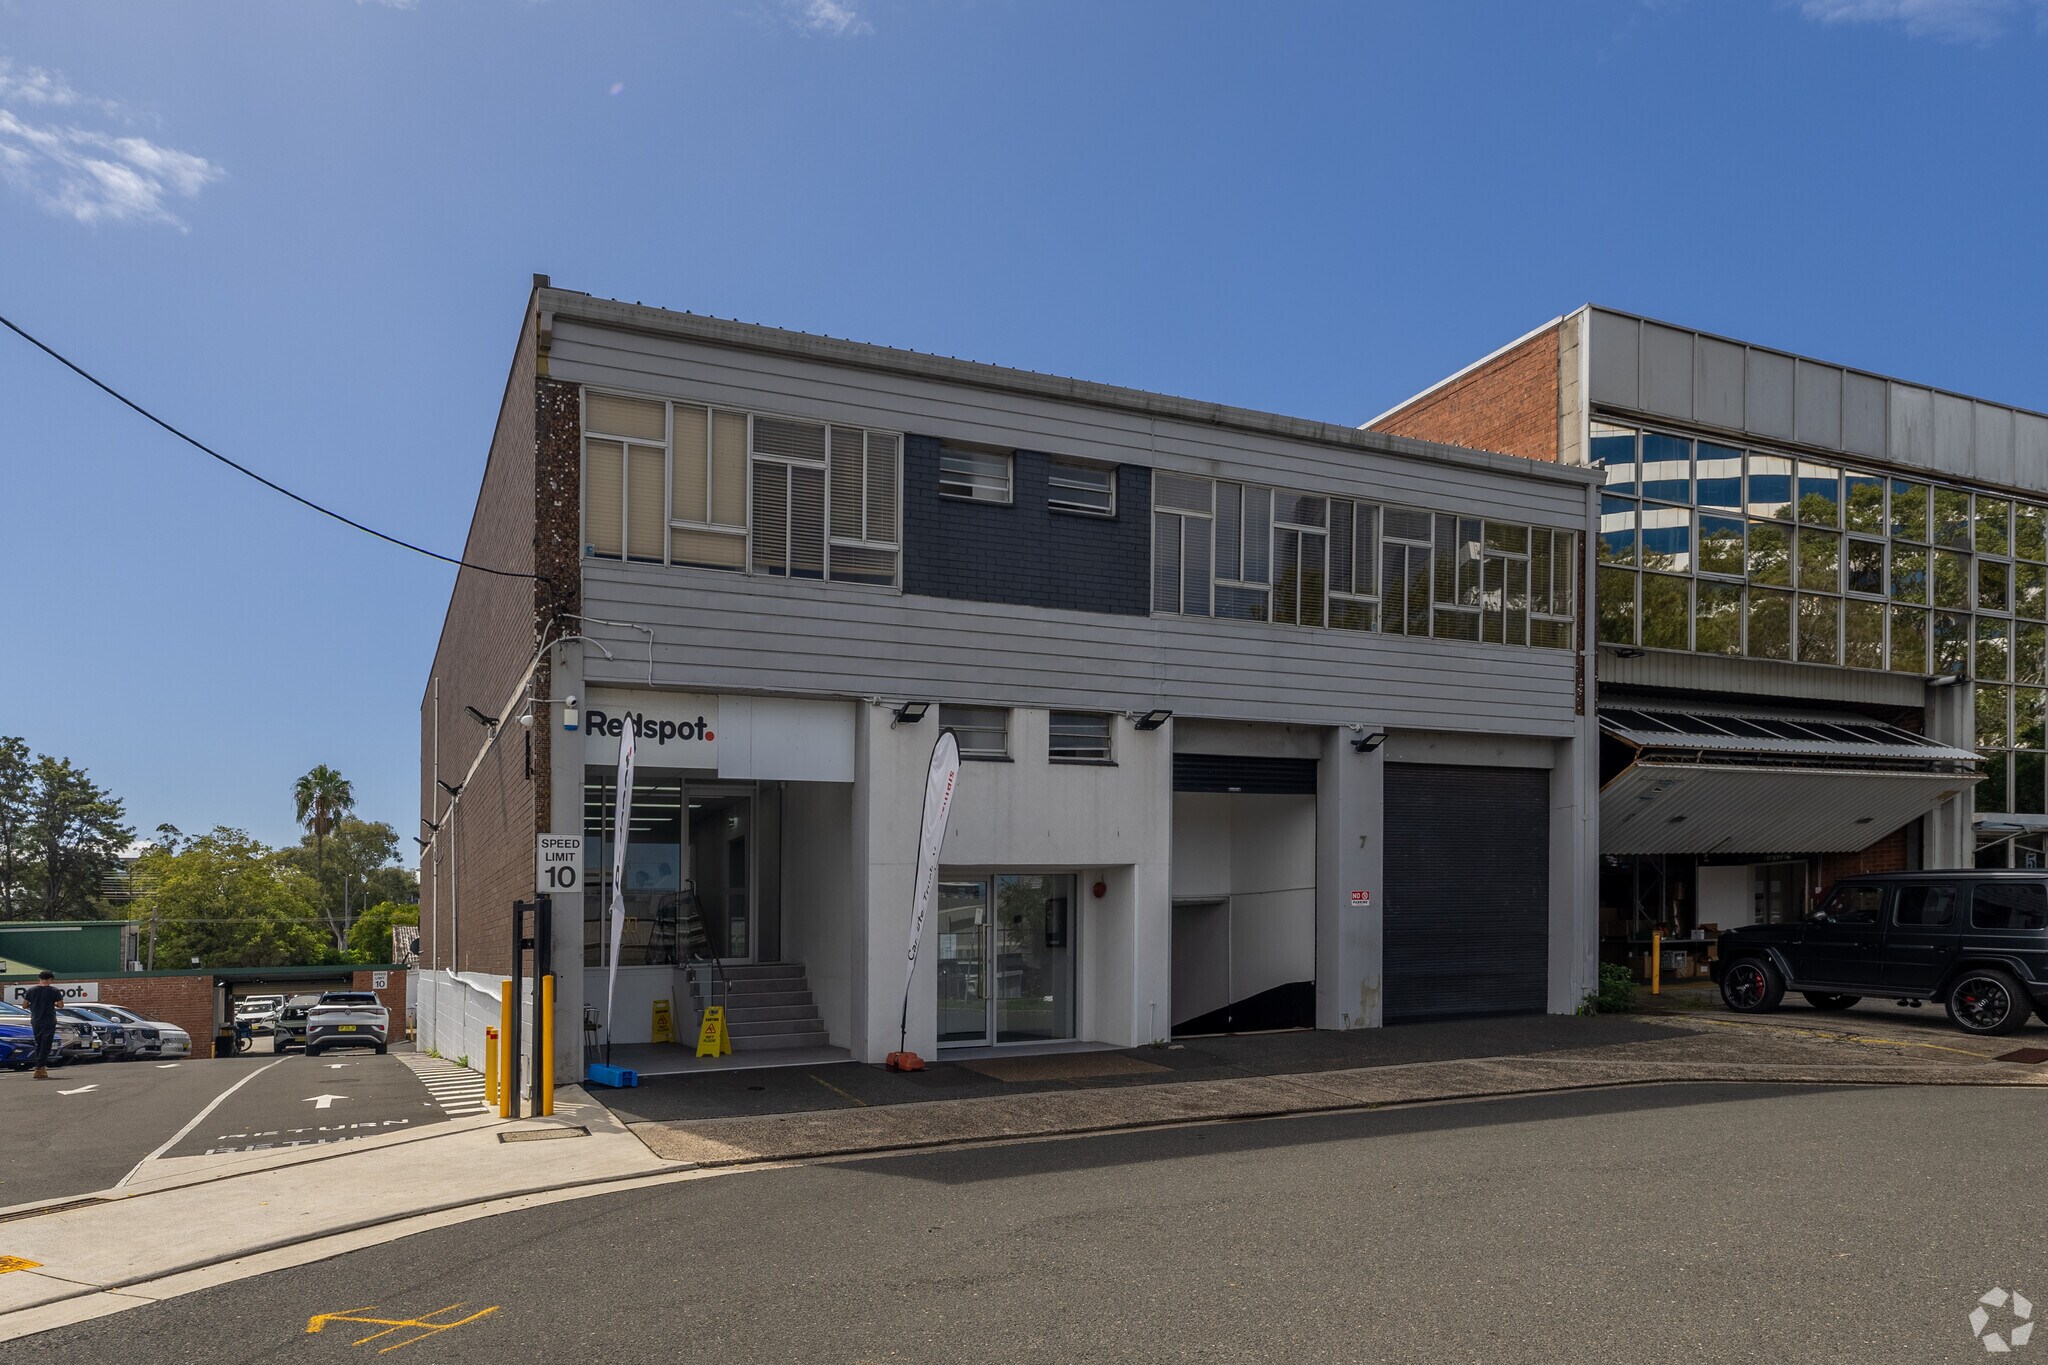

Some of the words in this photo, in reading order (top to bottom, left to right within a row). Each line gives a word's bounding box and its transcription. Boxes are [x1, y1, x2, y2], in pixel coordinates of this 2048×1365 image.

[541, 838, 580, 849] SPEED
[1359, 835, 1368, 849] 7
[545, 852, 576, 862] LIMIT
[544, 865, 576, 889] 10
[1352, 892, 1361, 900] NO
[375, 980, 386, 988] 10
